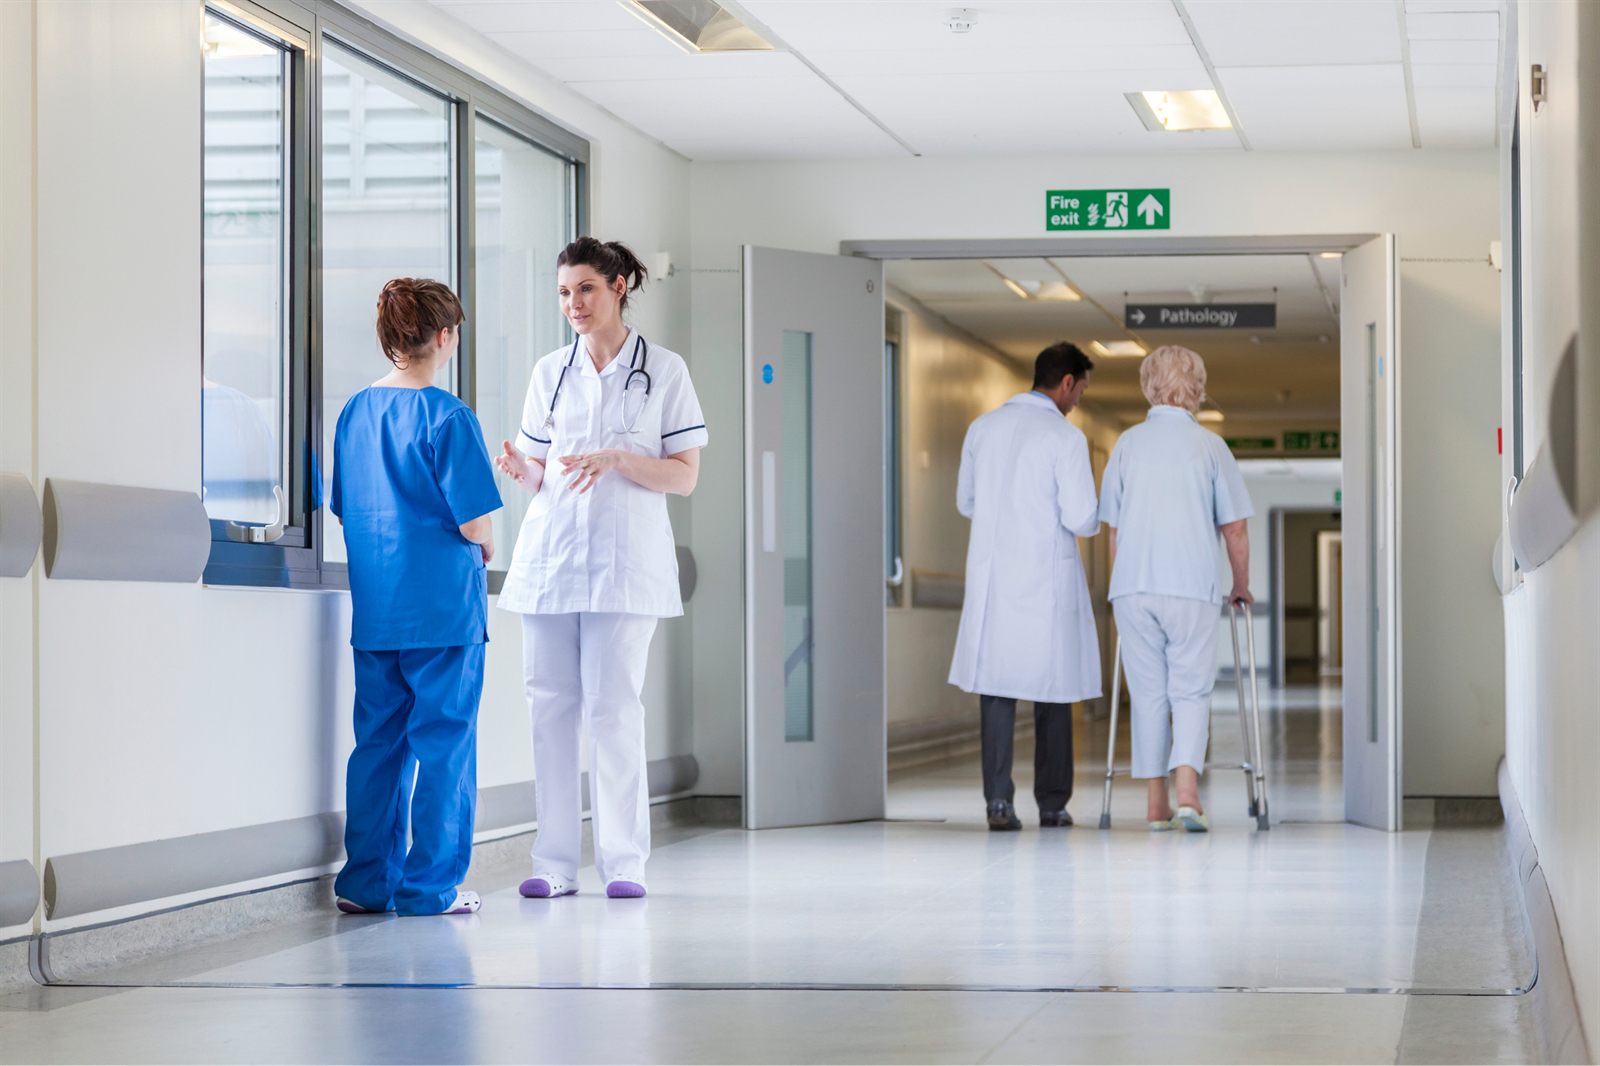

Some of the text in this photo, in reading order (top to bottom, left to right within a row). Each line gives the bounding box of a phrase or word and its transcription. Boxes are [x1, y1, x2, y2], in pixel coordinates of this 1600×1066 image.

[1050, 196, 1080, 209] Fire
[1050, 212, 1080, 225] exit
[1160, 308, 1238, 327] Pathology
